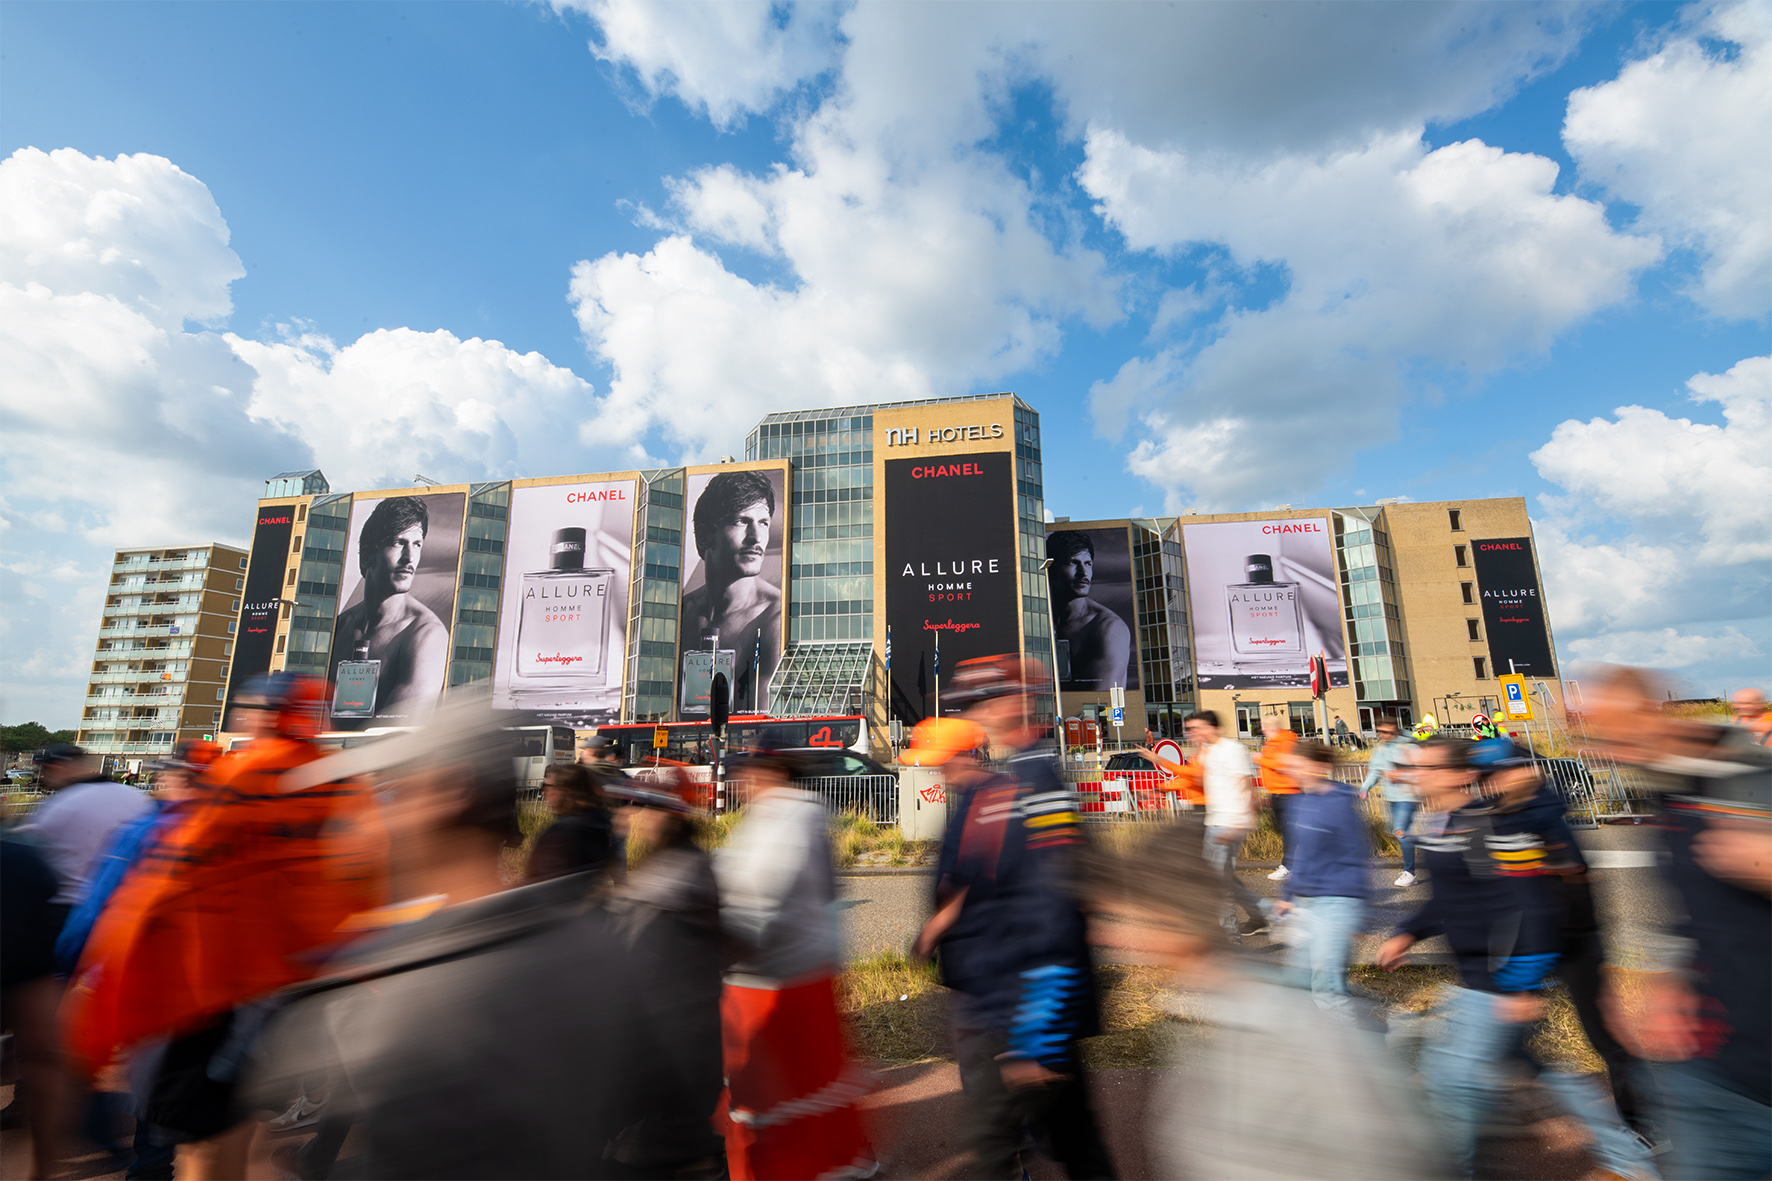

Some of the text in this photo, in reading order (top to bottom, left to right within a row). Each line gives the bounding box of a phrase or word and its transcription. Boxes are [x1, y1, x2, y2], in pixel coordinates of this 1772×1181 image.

[928, 423, 1003, 443] HOTELS
[911, 463, 983, 479] CHANEL
[566, 490, 626, 503] CHANEL
[259, 516, 291, 525] CHANEL
[1262, 523, 1321, 535] CHANEL
[1480, 543, 1522, 551] CHANEL
[902, 559, 999, 576] ALLURE
[525, 584, 605, 599] ALLURE
[928, 582, 972, 591] HOMME
[928, 592, 972, 602] SPORT
[1231, 592, 1295, 603] ALLURE
[1483, 589, 1536, 597] ALLURE
[244, 602, 279, 610] ALLURE
[545, 614, 581, 622] SPORT
[923, 619, 980, 633] Superleggera
[1249, 637, 1286, 646] Superleggera
[535, 652, 582, 665] Superleggera
[687, 657, 731, 666] ALLRE
[1508, 685, 1518, 699] P
